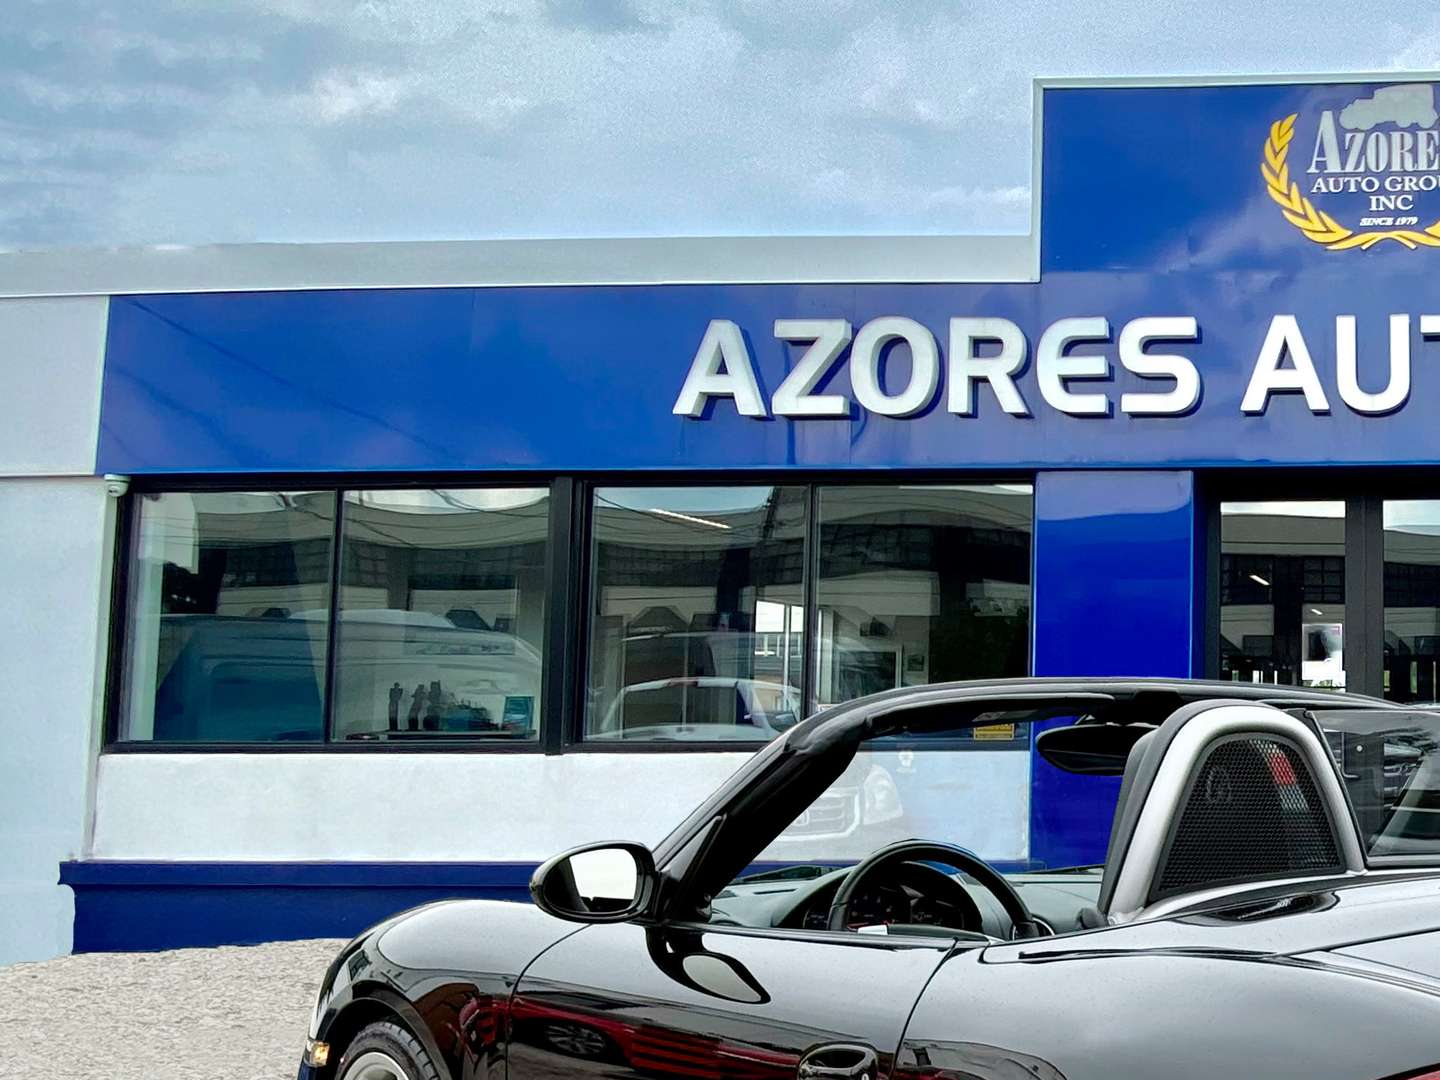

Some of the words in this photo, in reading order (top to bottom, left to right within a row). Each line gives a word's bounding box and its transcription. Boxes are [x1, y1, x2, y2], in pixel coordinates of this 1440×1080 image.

[1311, 175, 1380, 193] AUTO
[1369, 195, 1415, 211] INC
[1360, 217, 1394, 226] SINCE
[1395, 216, 1418, 226] 1979
[673, 316, 1204, 417] AZORES
